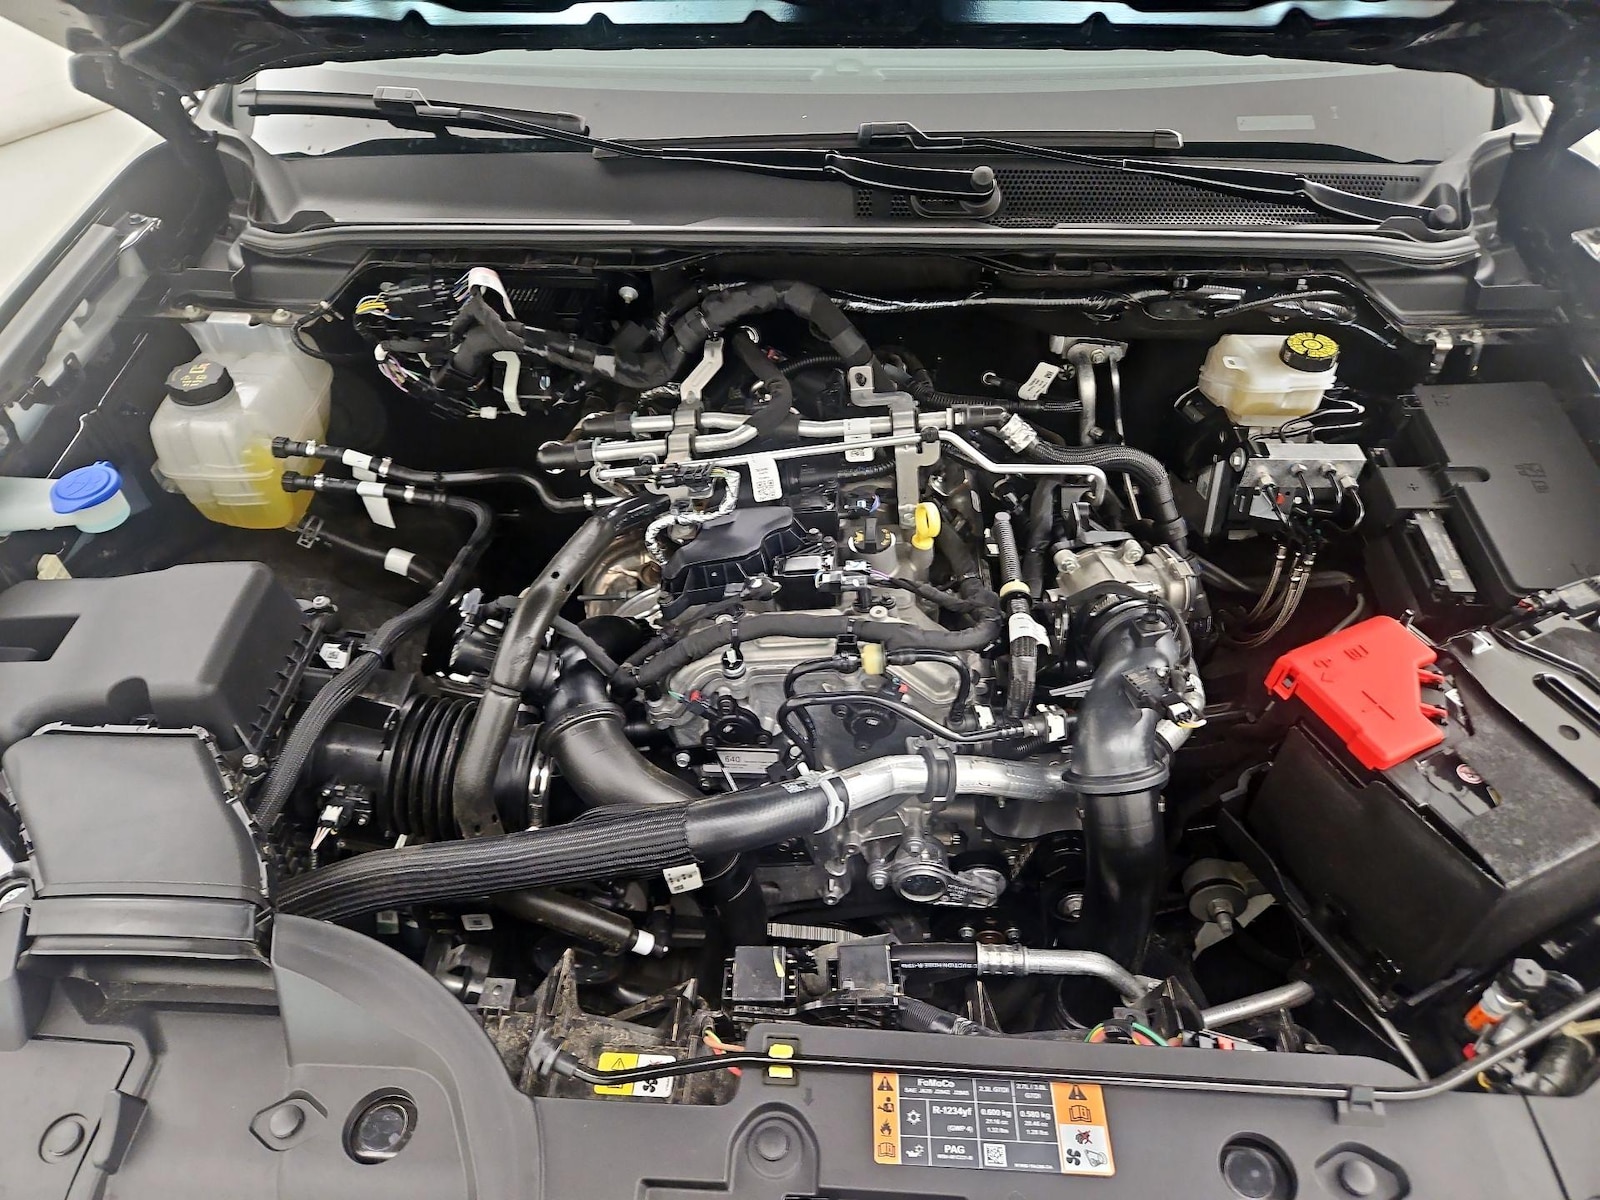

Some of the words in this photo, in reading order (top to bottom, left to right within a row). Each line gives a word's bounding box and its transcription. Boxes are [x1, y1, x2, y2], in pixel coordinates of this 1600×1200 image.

[917, 1078, 955, 1088] FoMoCo
[932, 1105, 973, 1118] R-1234yf
[1001, 1109, 1012, 1118] kg
[1040, 1111, 1051, 1120] kg
[944, 1144, 966, 1154] PAG
